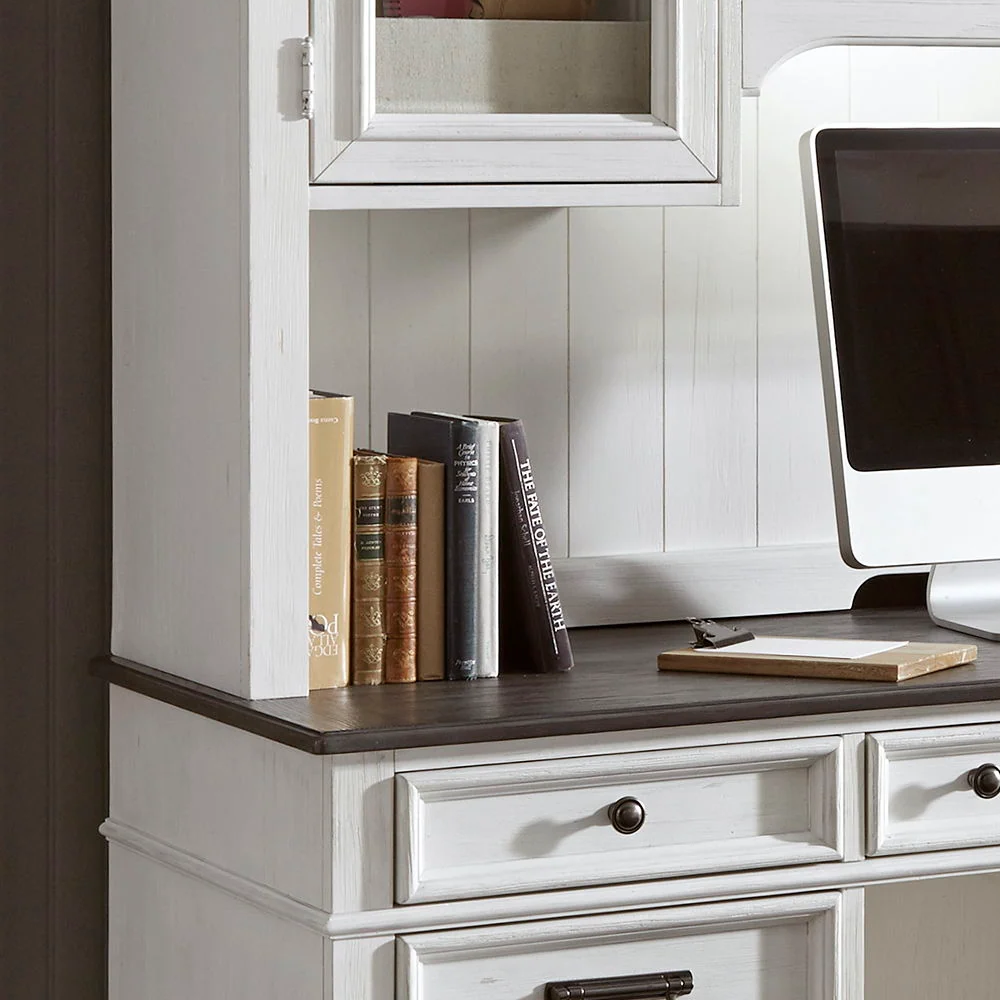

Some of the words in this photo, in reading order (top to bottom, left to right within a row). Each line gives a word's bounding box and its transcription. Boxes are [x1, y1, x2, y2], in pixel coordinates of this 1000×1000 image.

[519, 458, 536, 492] THE
[312, 478, 323, 508] Poems
[313, 511, 322, 522] &
[525, 493, 543, 526] FATE
[312, 525, 322, 547] Tales
[534, 528, 547, 549] OF
[312, 551, 325, 596] Complete
[538, 548, 553, 580] THE
[544, 581, 566, 632] EARTH
[307, 613, 339, 637] PO
[307, 634, 338, 647] ALLA
[307, 644, 338, 657] EDGA
